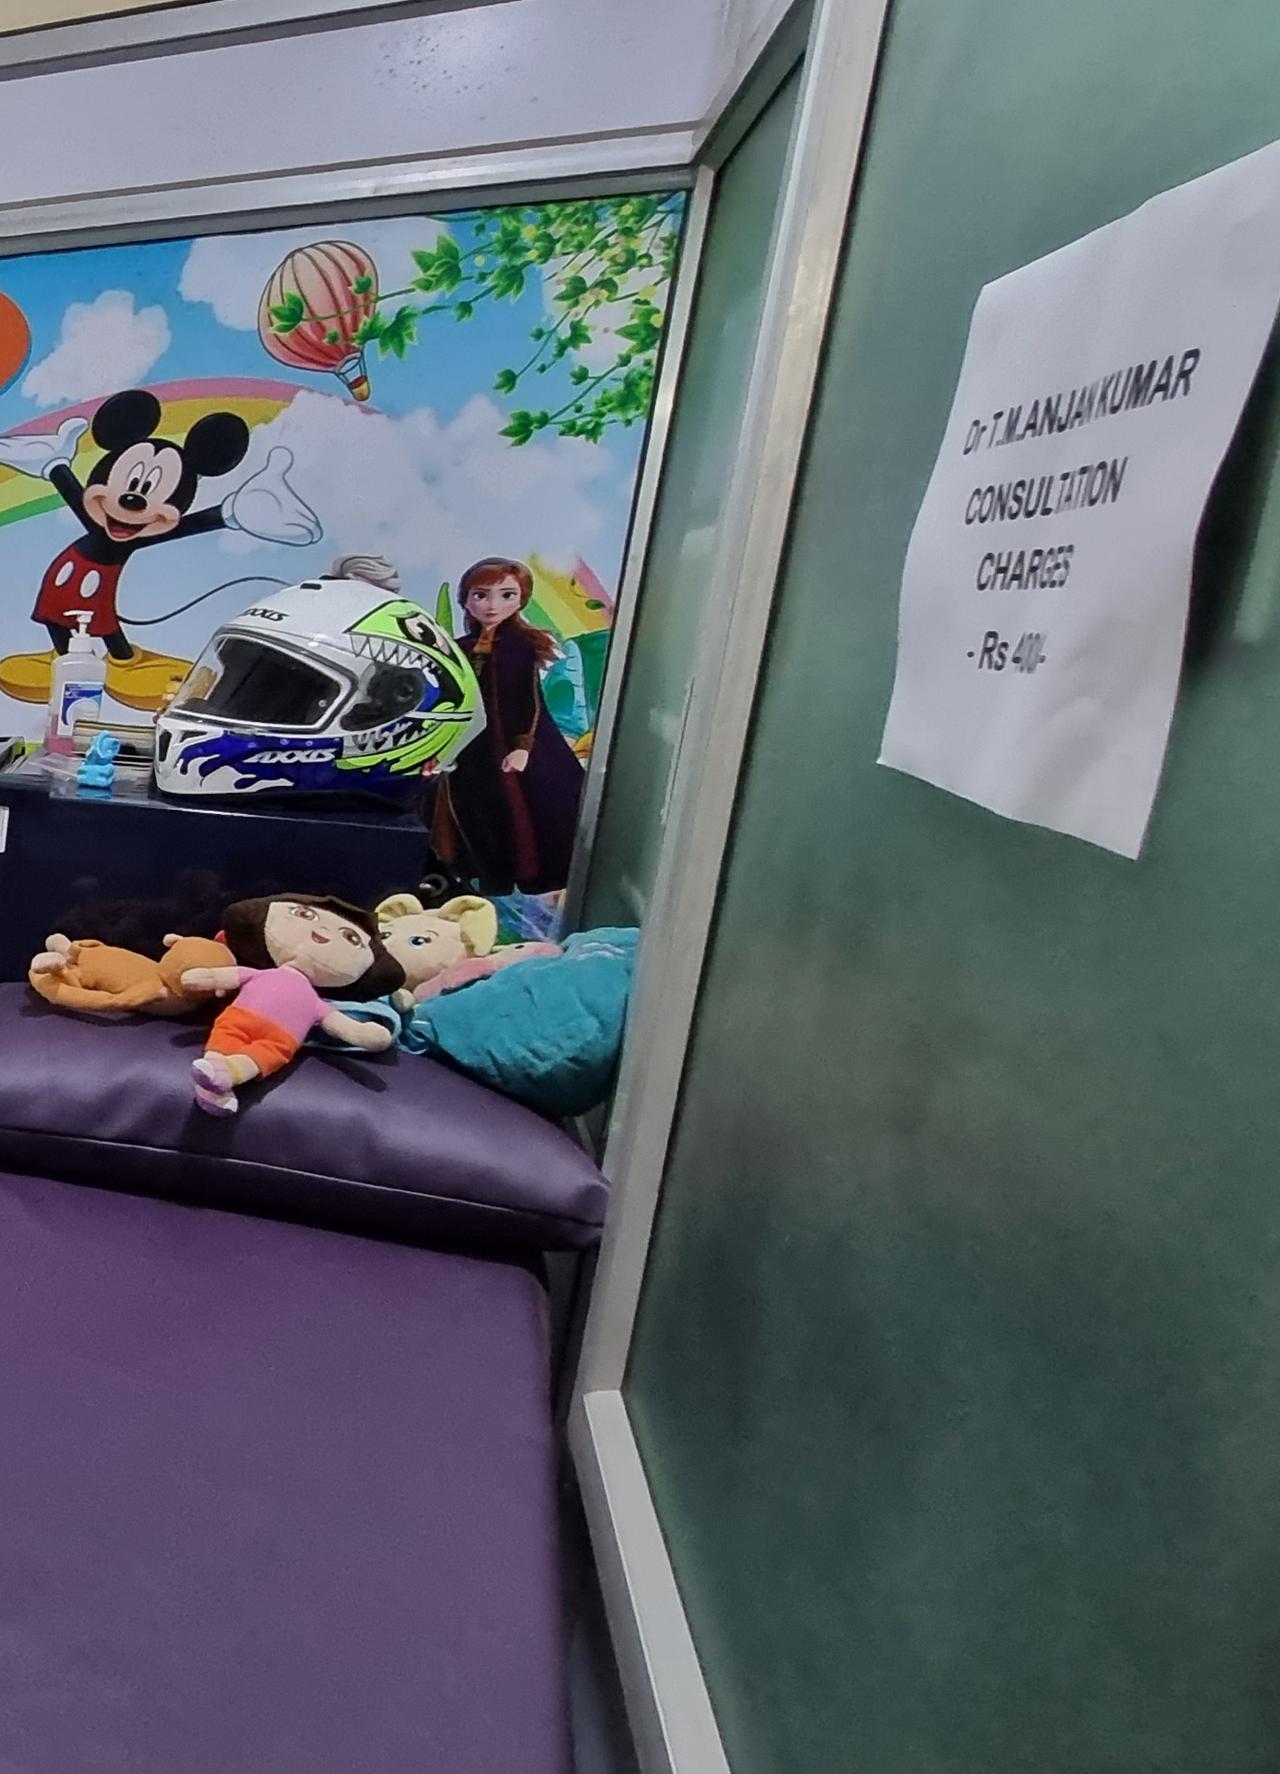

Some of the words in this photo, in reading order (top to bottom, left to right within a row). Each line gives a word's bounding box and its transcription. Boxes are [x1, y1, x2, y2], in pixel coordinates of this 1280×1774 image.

[963, 418, 988, 456] Dr
[1095, 347, 1201, 420] KUMAR
[964, 456, 1129, 526] CONSULTATION
[976, 544, 1075, 591] CHARGES
[978, 630, 1010, 672] Rs
[242, 748, 338, 764] AXXIS
